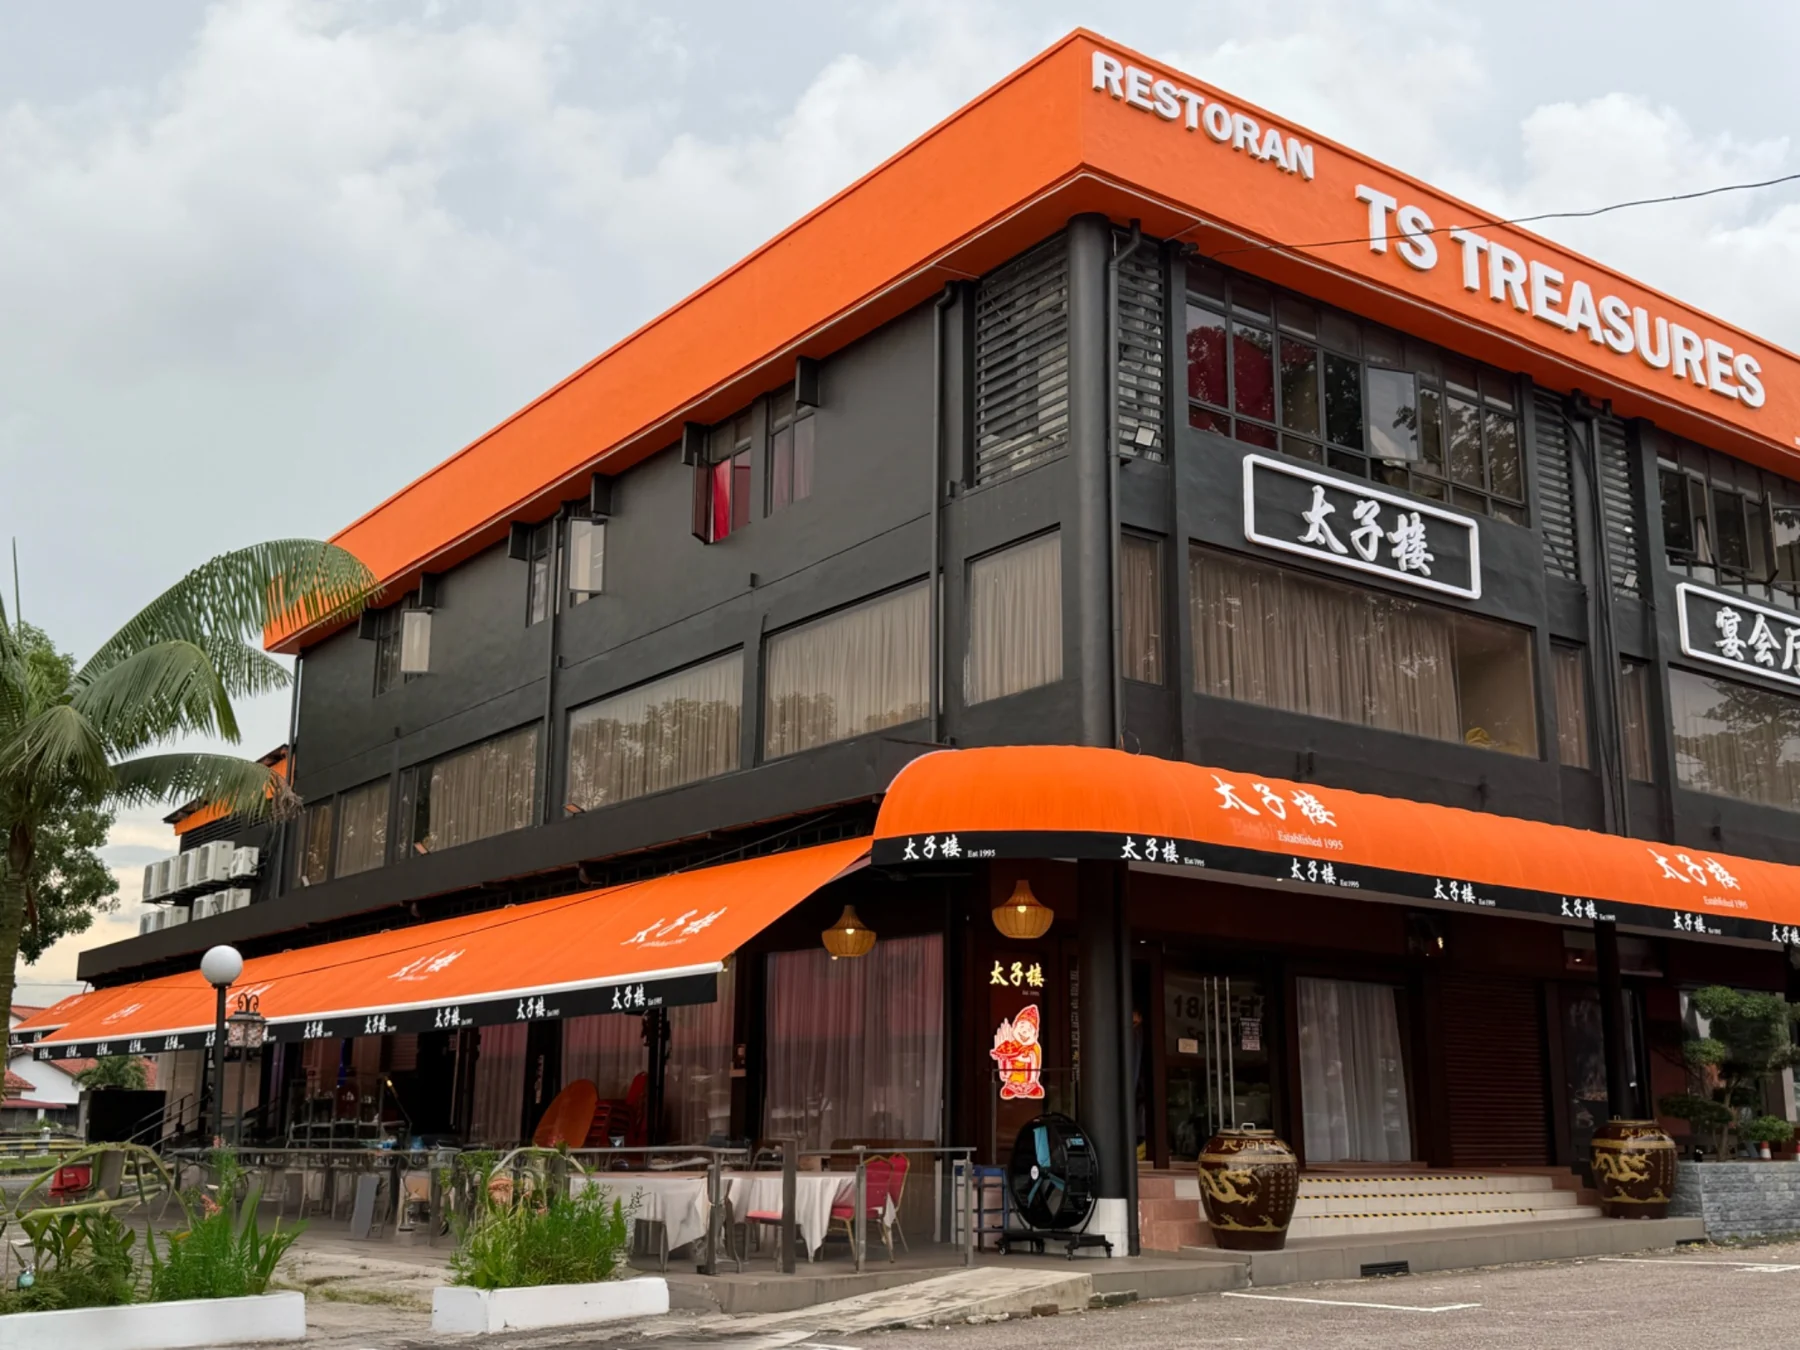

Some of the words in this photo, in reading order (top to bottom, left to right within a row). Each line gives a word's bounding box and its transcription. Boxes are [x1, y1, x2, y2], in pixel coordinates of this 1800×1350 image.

[1092, 50, 1315, 182] RESTORAN
[1355, 184, 1438, 272] TS
[1449, 225, 1767, 409] TREASURES
[1297, 484, 1435, 577] 太子楼
[1210, 774, 1338, 828] 太子楼
[902, 833, 963, 861] 太子楼
[979, 849, 996, 858] 1995
[1120, 835, 1180, 864] 太子楼
[1277, 830, 1322, 848] Established
[1324, 838, 1344, 851] 1995
[1290, 857, 1337, 885] 太子楼
[1433, 878, 1476, 905] 太子楼
[1561, 896, 1598, 920] 太子楼
[990, 960, 1045, 987] 太子楼
[516, 995, 546, 1020] 太子楼
[611, 983, 646, 1010] 太子楼
